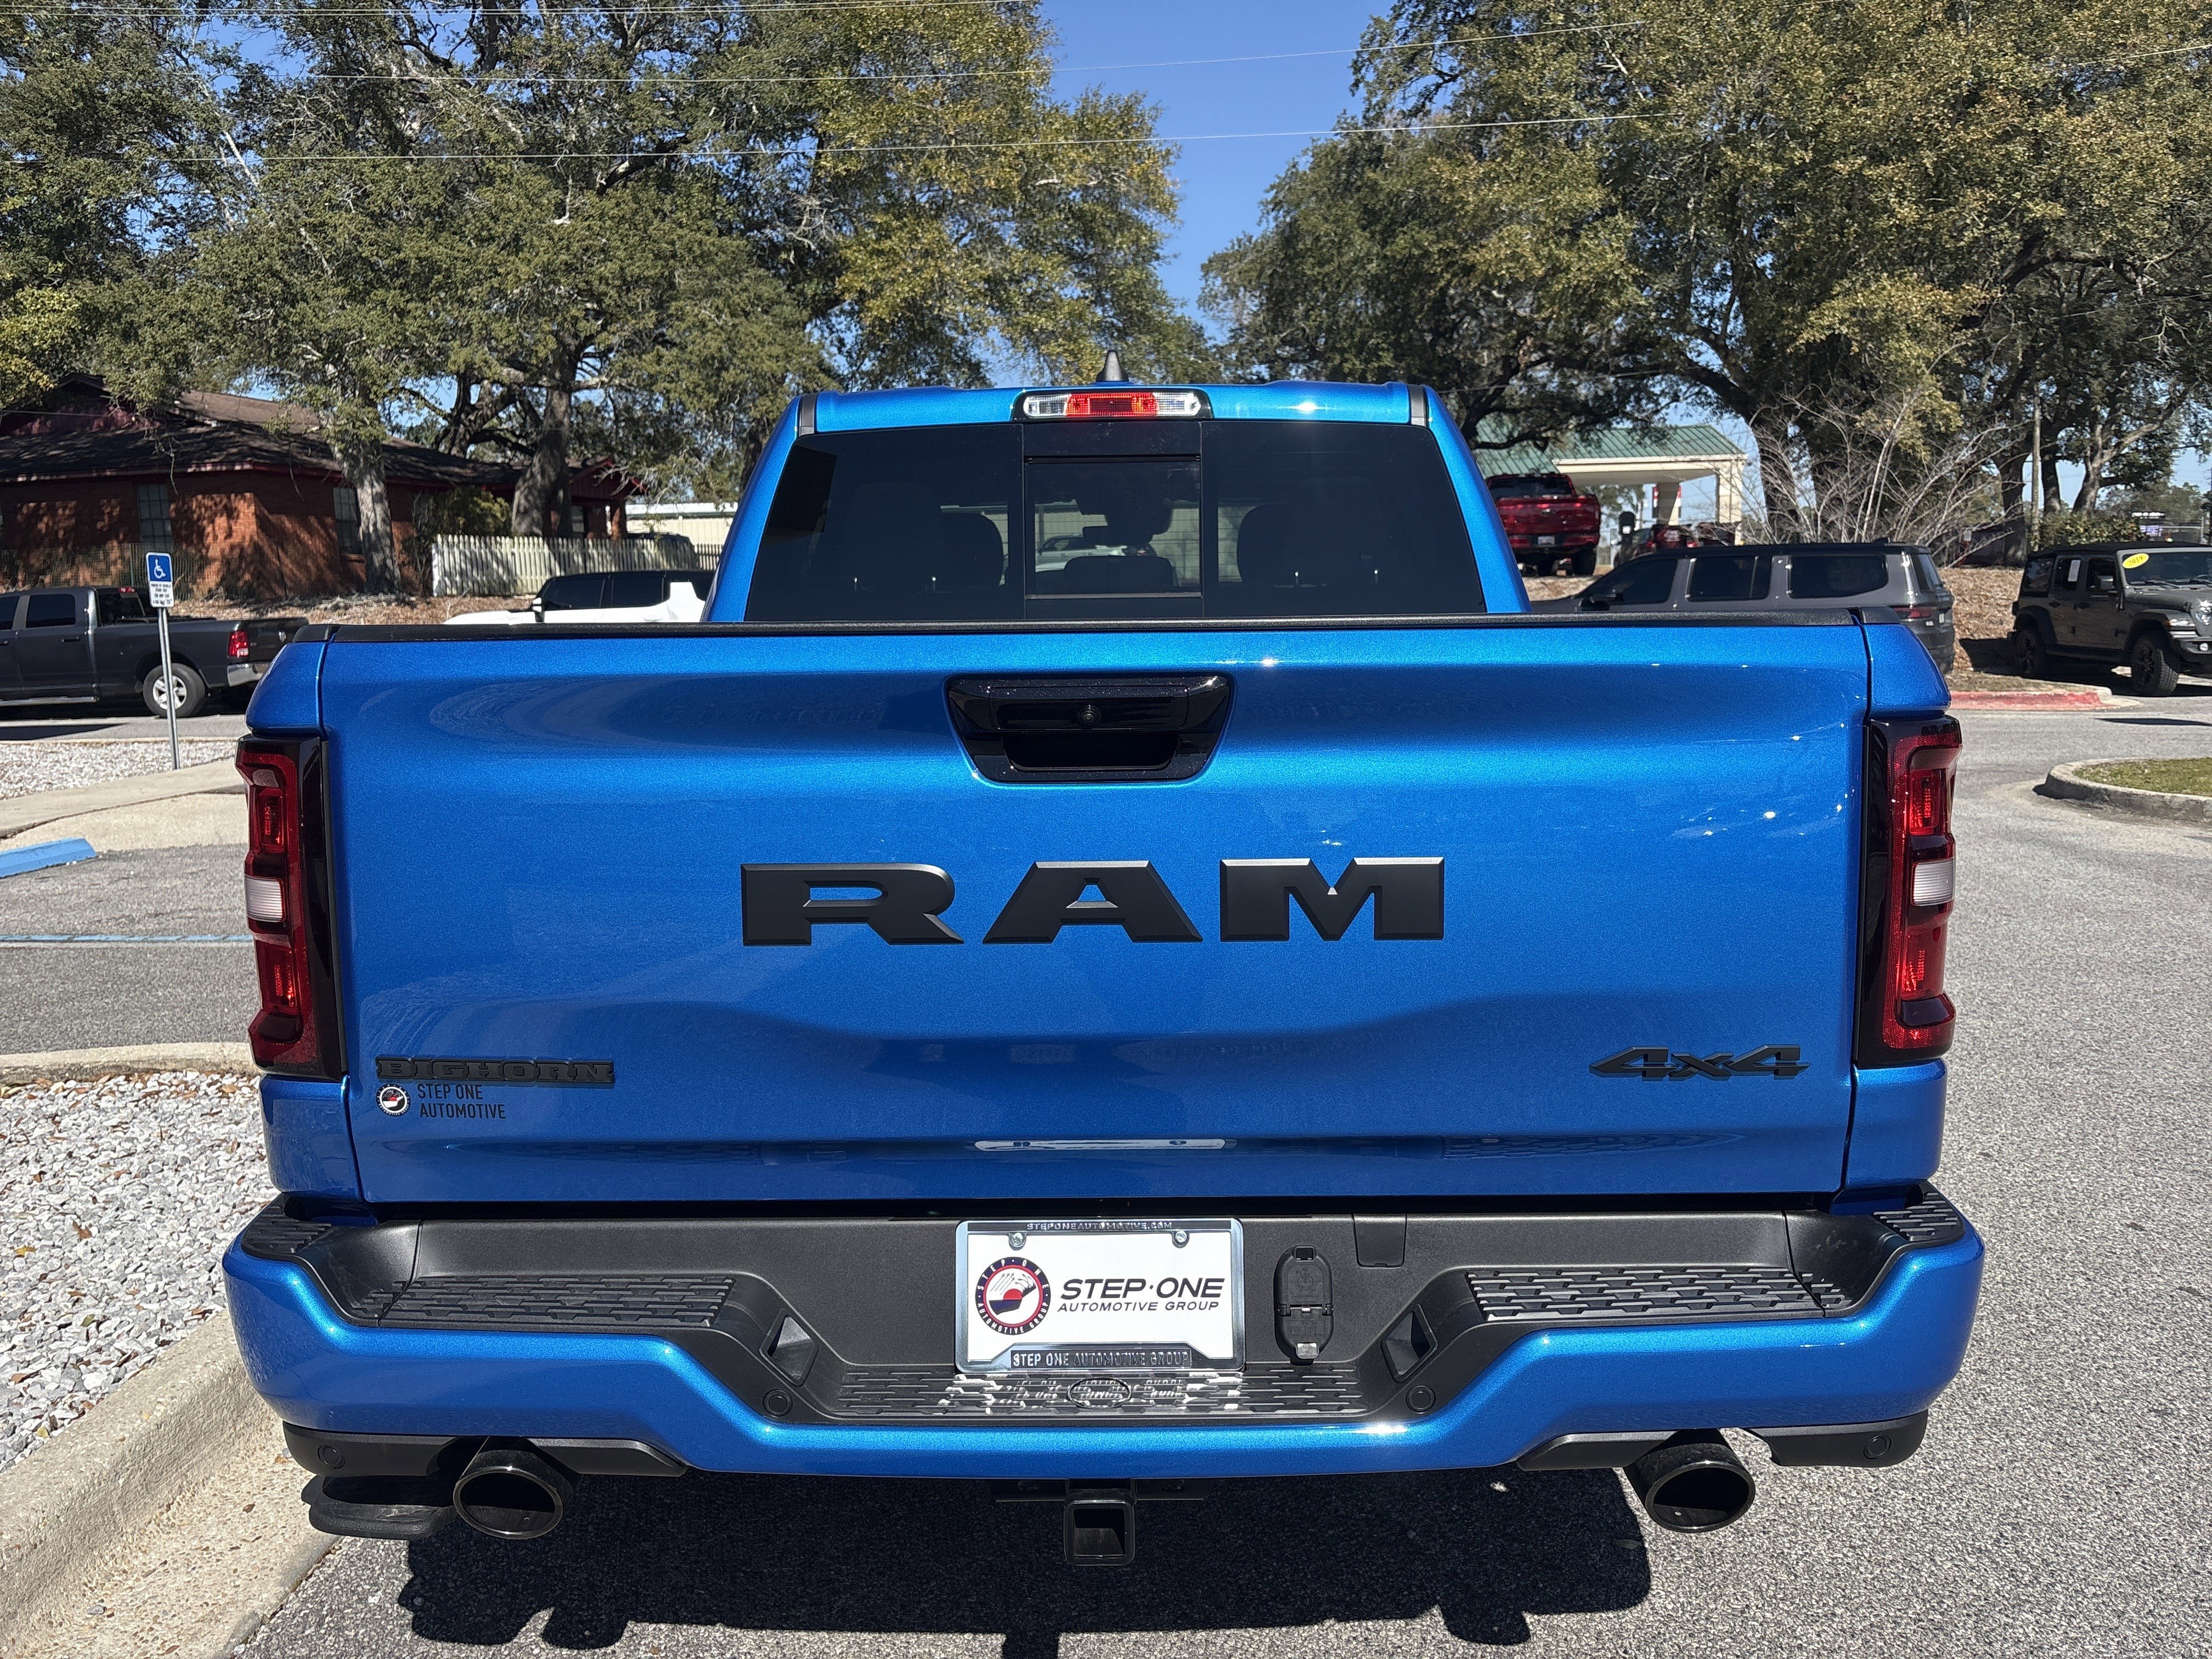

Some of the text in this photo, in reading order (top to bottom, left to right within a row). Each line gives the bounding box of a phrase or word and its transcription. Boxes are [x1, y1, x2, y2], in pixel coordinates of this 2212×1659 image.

[741, 856, 1444, 945] RAM
[375, 1056, 614, 1084] BIGHORN
[417, 1084, 483, 1100] STEP ONE
[419, 1103, 506, 1119] AUTOMOTIVE
[1026, 1222, 1172, 1230] STEPONEAUTOMOTIVE.COM
[1057, 1301, 1219, 1312] AUTOMOTIVE GROUP
[977, 1302, 1048, 1334] AUTOMOTIVE GROUP
[1013, 1351, 1189, 1366] STEP ONE AUTOMOTIVE GROUP
